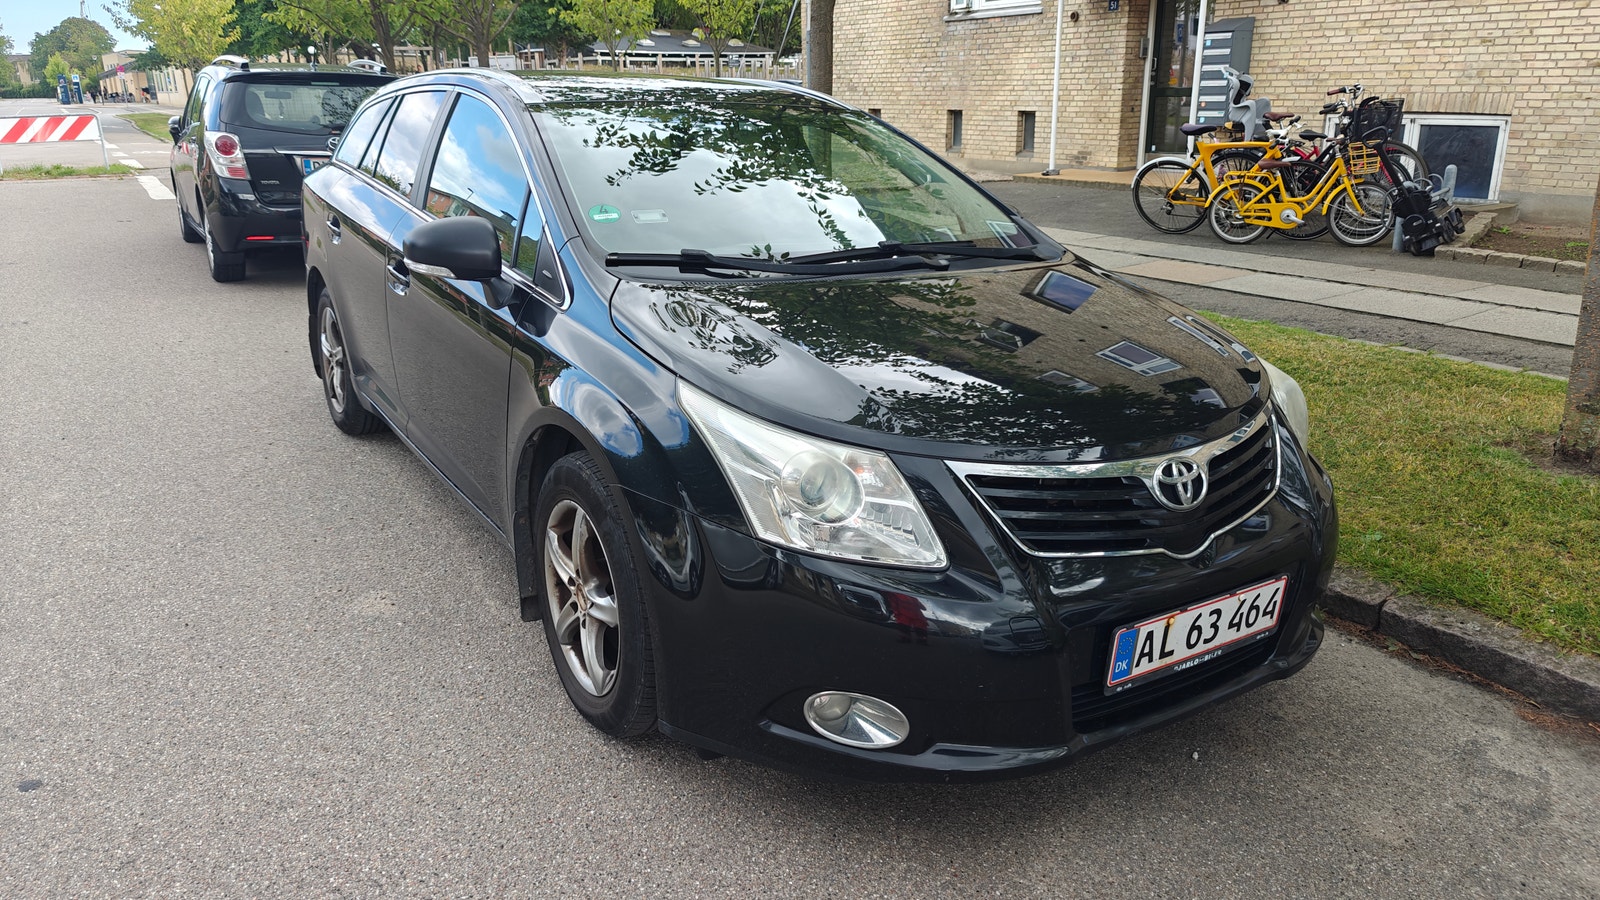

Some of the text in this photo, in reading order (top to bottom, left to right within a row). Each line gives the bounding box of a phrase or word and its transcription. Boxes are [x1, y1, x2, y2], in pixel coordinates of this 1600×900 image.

[1110, 1, 1117, 9] 51
[1135, 587, 1280, 668] AL 63 464
[1115, 658, 1128, 673] DK
